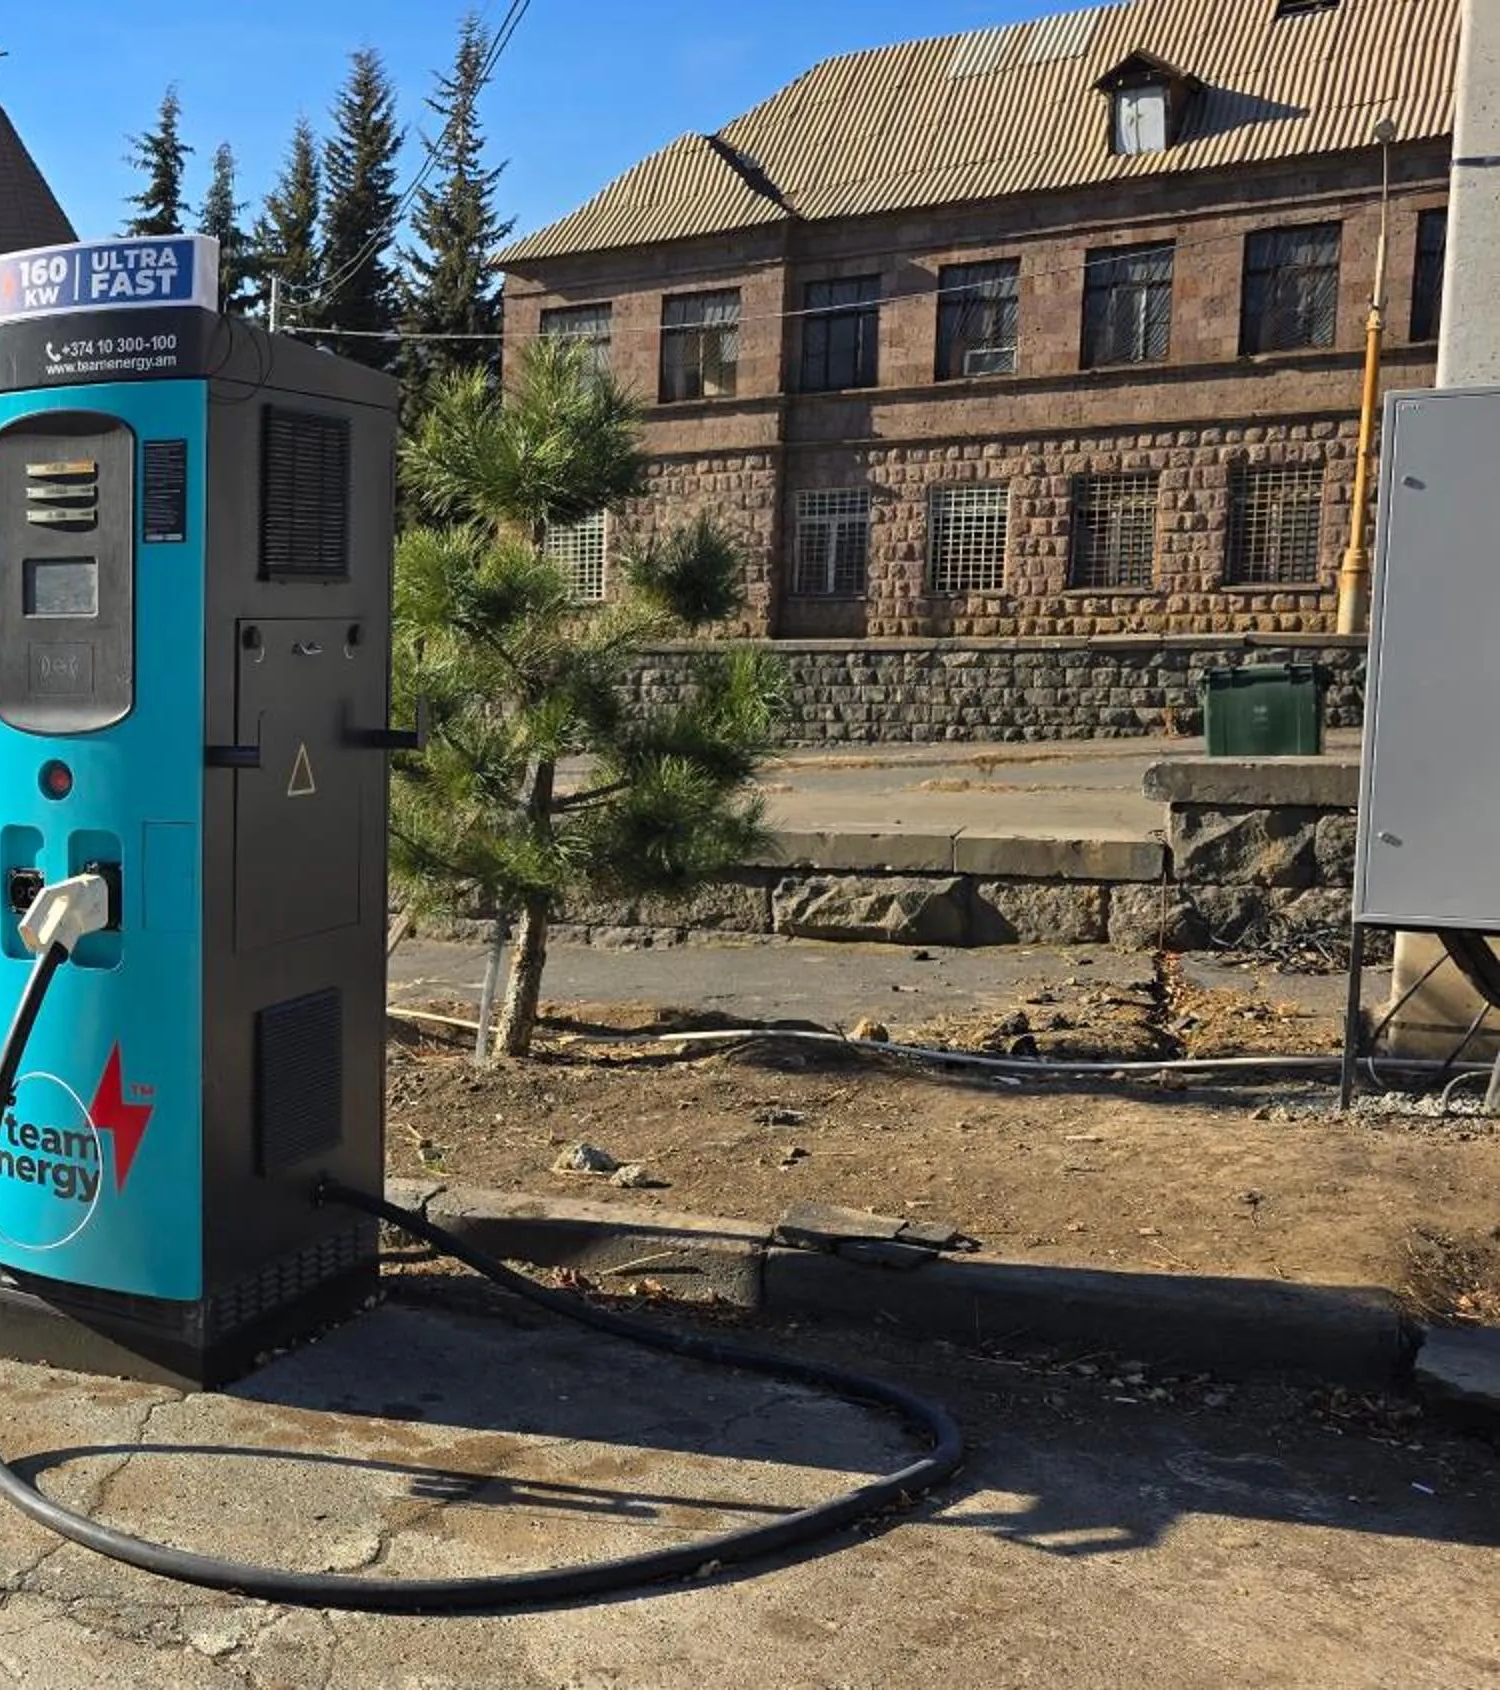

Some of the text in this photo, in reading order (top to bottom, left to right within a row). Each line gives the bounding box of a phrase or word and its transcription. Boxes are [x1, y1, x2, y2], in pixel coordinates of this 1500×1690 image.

[19, 255, 68, 288] 160
[90, 247, 178, 272] ULTRA
[90, 267, 178, 299] FAST
[24, 286, 61, 308] KW
[61, 334, 177, 357] +374 10 300-100
[45, 355, 177, 375] www.teamenergy.am
[4, 1113, 100, 1163] team
